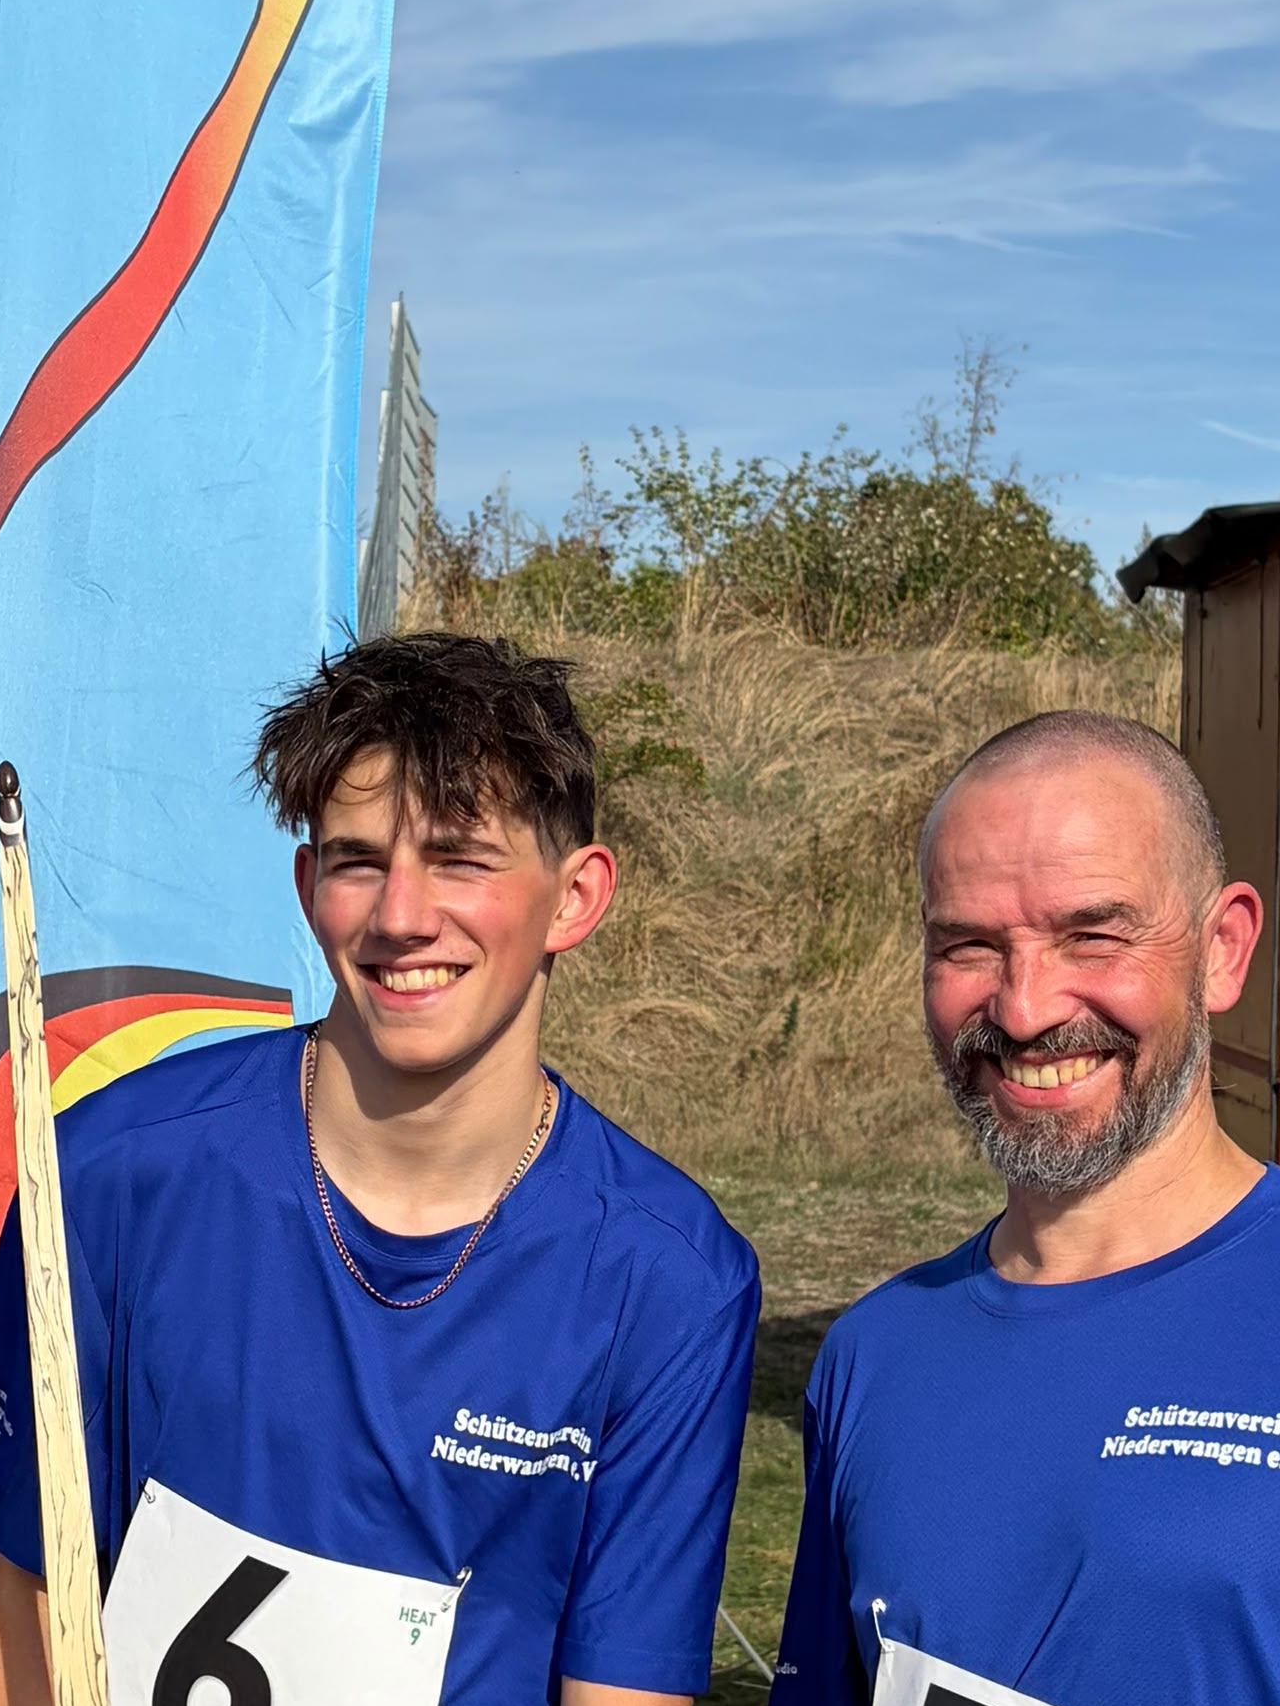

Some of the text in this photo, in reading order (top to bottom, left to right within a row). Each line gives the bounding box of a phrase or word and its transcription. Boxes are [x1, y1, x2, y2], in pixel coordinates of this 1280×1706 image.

[454, 1408, 592, 1454] Schützenverein
[431, 1435, 571, 1475] Niederwangen
[1100, 1434, 1262, 1466] Niederwangen
[399, 1606, 438, 1627] HEAT
[410, 1628, 421, 1645] 9
